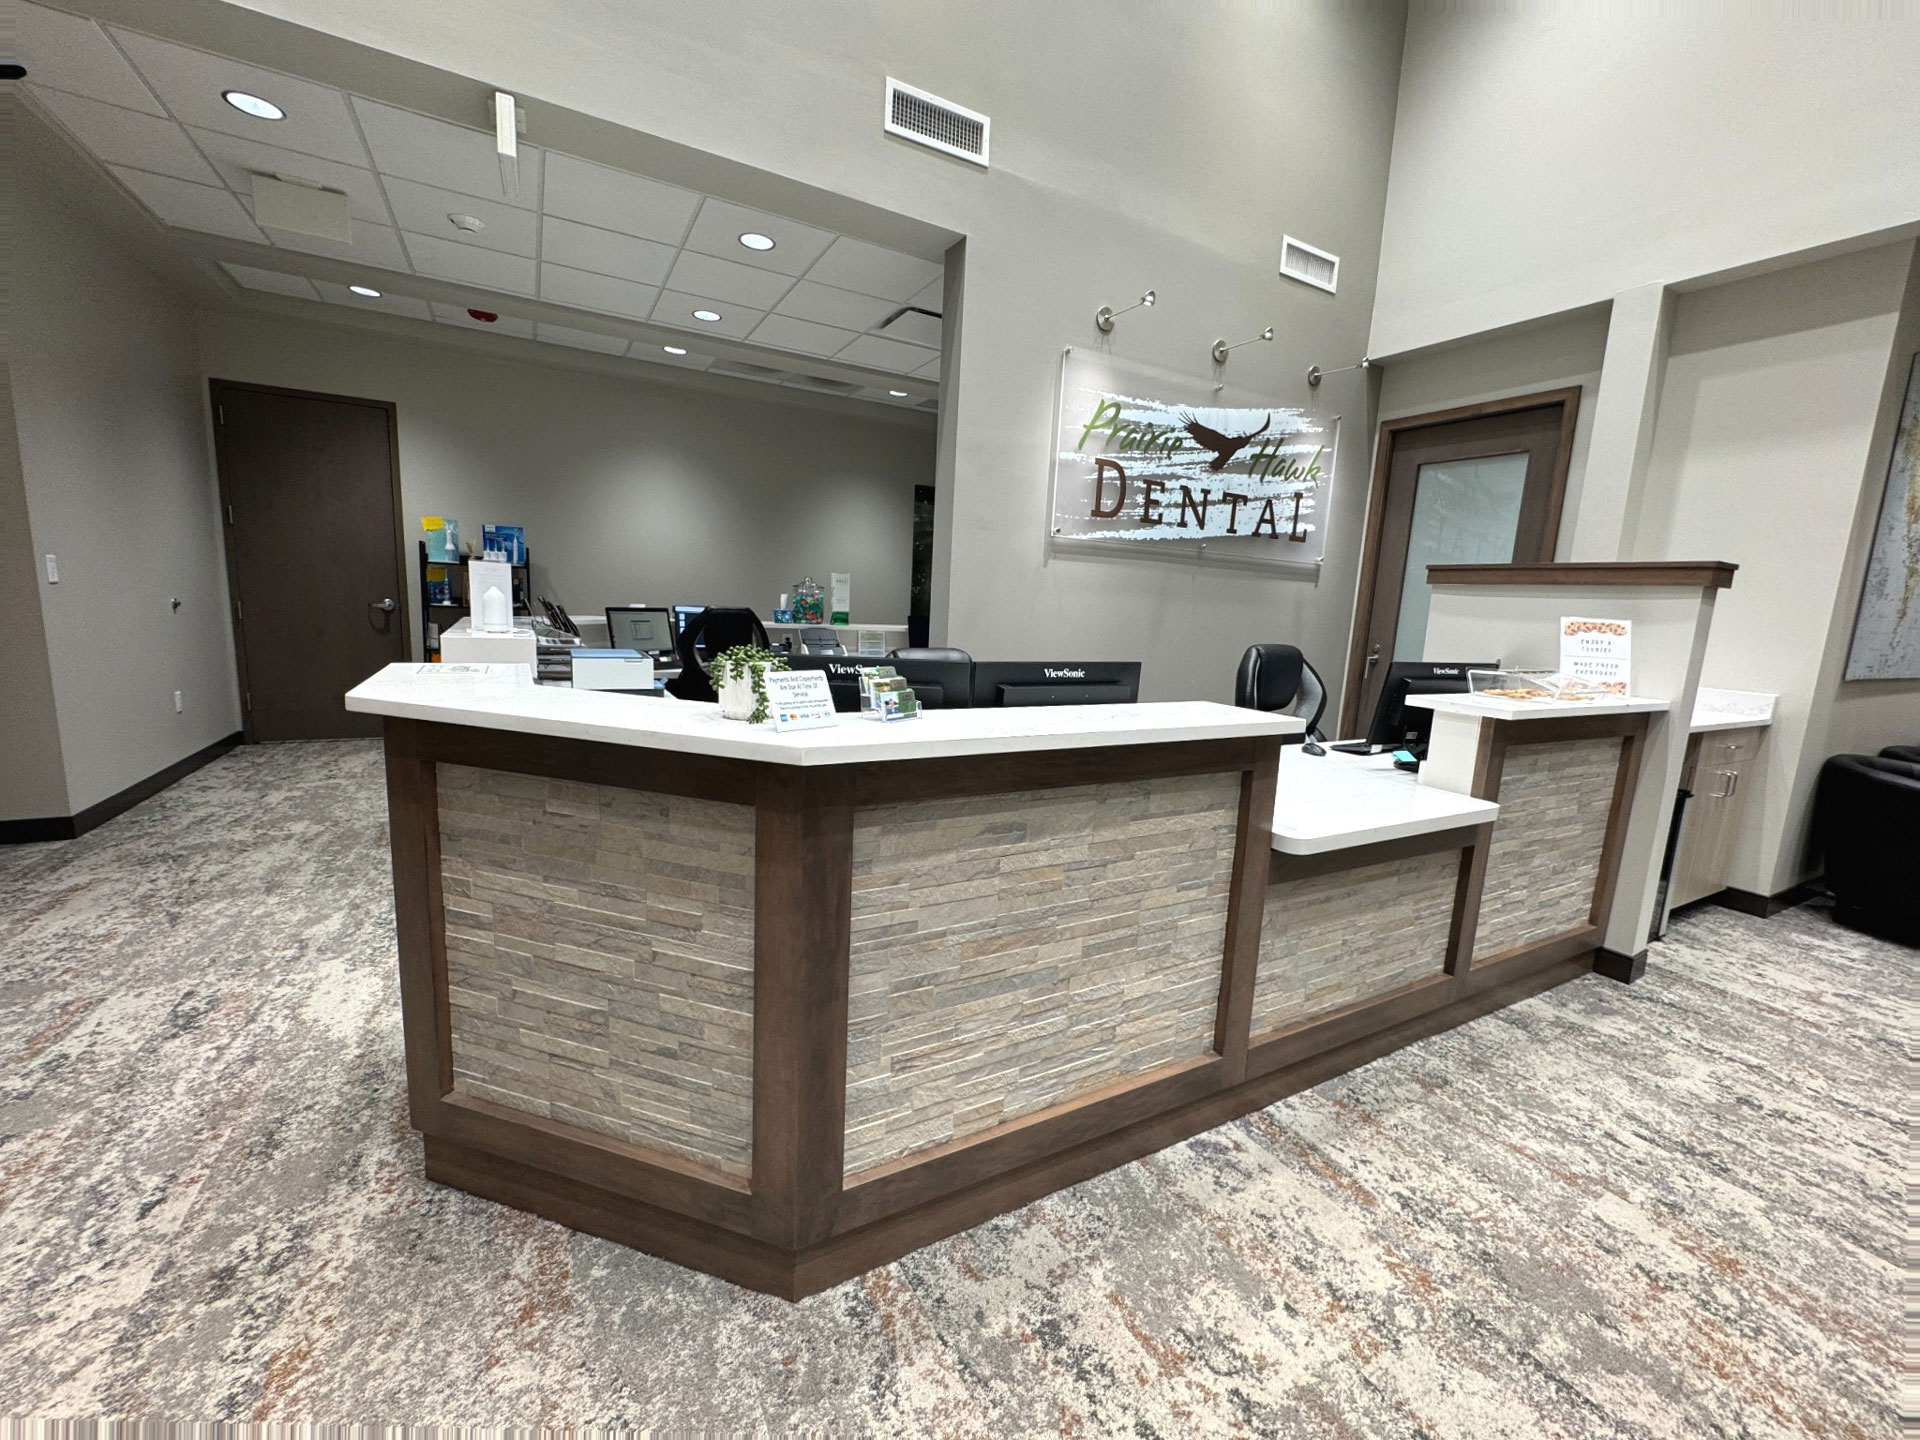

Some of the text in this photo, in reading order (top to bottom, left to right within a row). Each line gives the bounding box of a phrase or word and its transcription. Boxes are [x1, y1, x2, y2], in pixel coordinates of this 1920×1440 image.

[1077, 398, 1324, 486] Prairie Hawk
[1090, 457, 1308, 543] DENTAL
[828, 663, 863, 674] ViewS
[1044, 668, 1085, 678] ViewSonic
